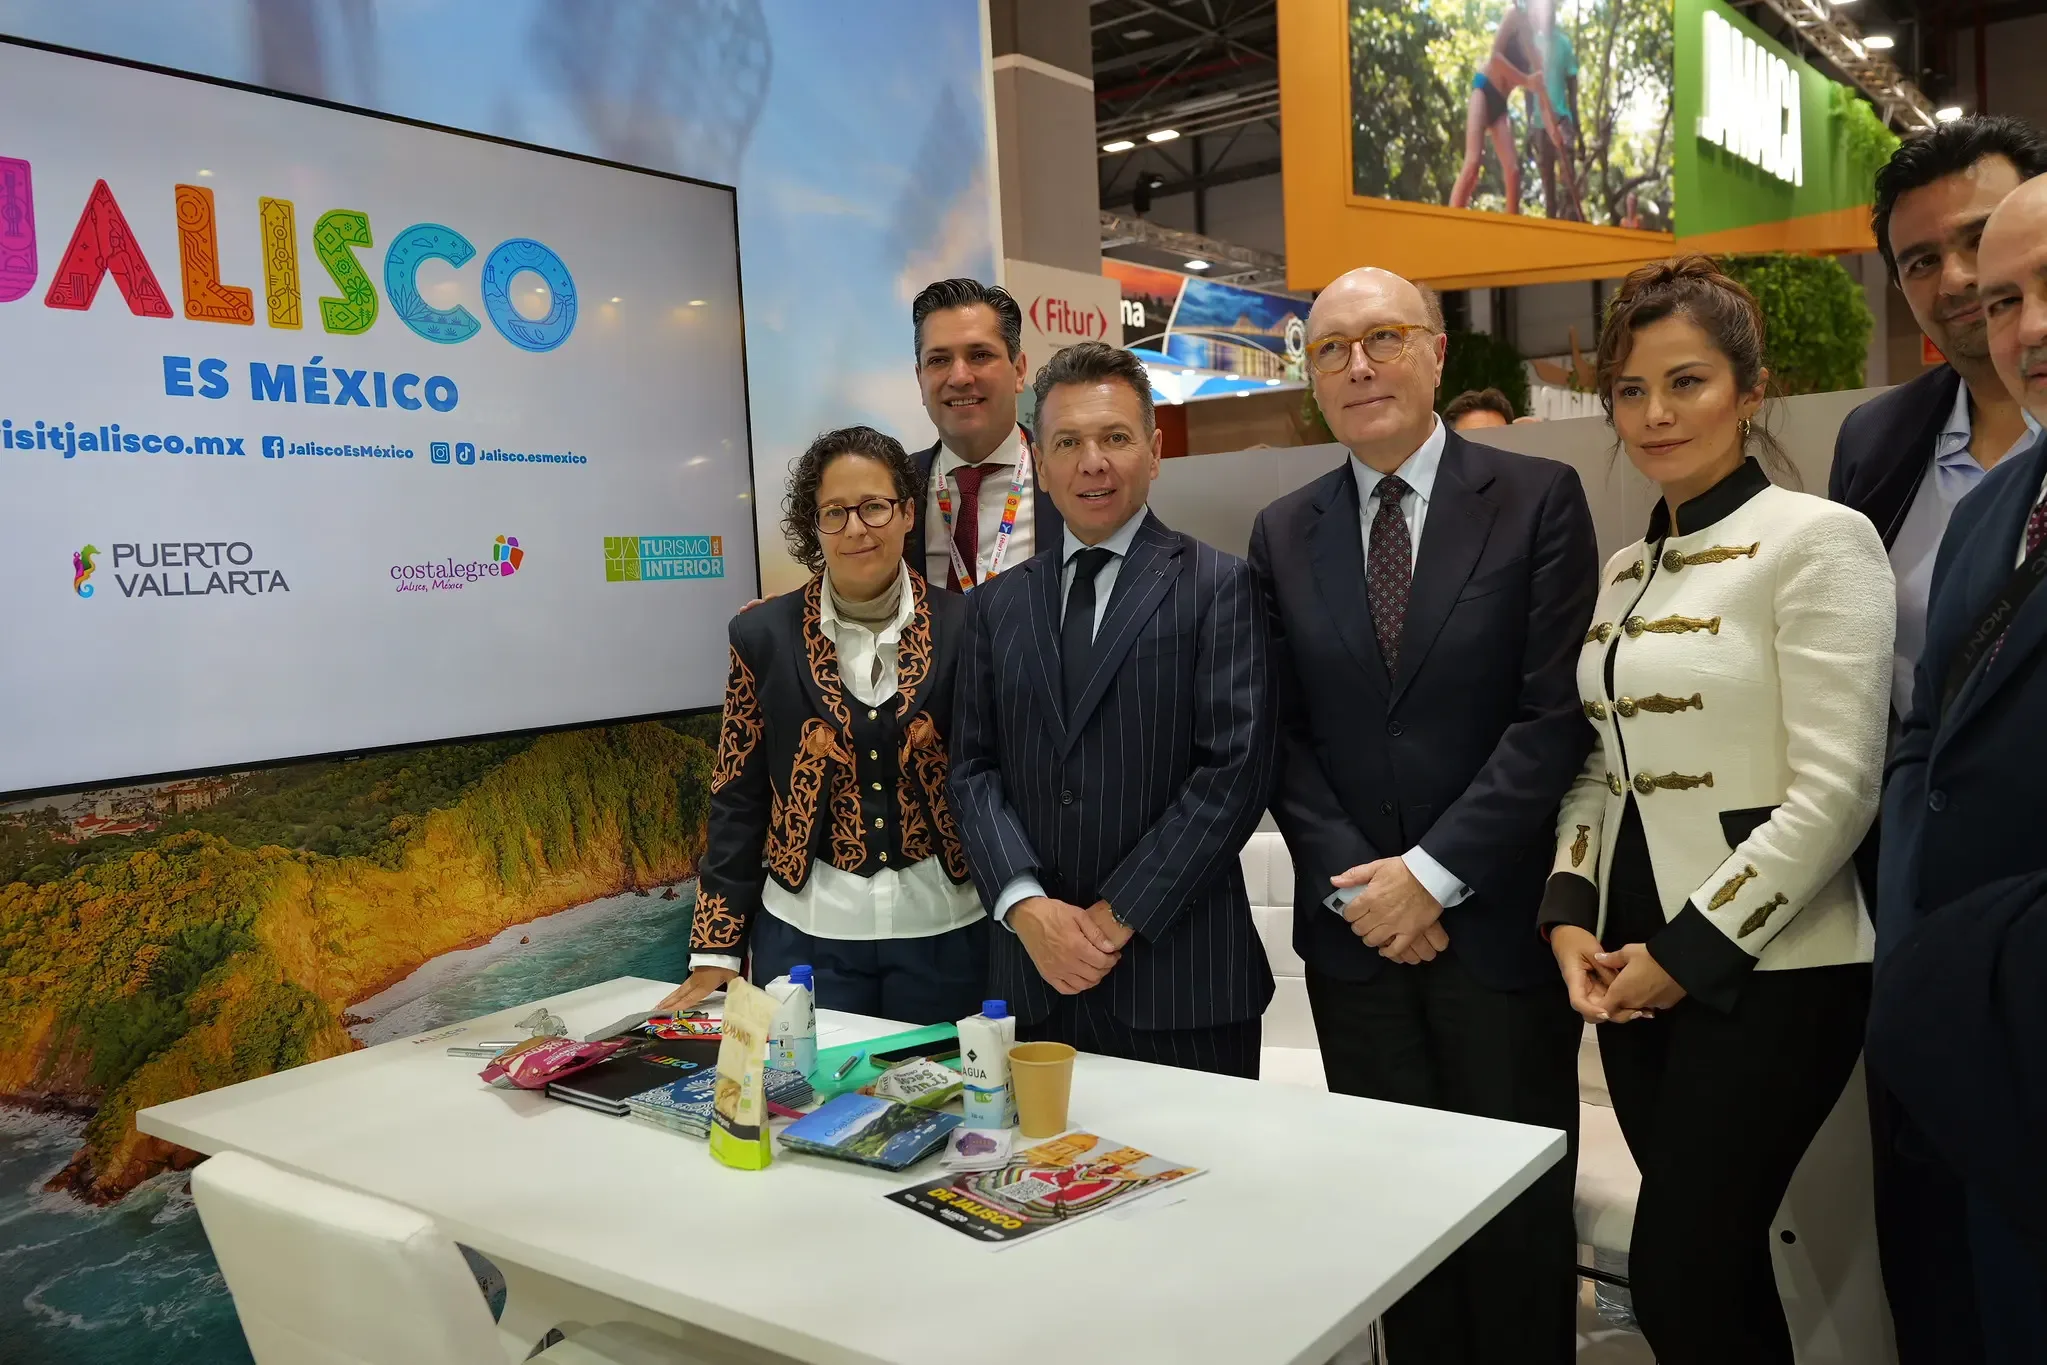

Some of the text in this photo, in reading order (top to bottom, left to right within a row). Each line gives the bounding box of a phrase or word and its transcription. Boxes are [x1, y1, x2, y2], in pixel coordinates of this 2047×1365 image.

[163, 355, 459, 412] ES MÉXICO
[0, 419, 246, 459] isitjalisco.mx
[288, 442, 414, 460] JaliscoEsMéxico
[479, 449, 588, 465] Jalisco.esmexico
[112, 541, 254, 569] PUERTO
[641, 539, 710, 556] TURISMO
[390, 557, 500, 582] costalegre
[645, 558, 722, 577] INTERIOR
[114, 569, 291, 597] VALLARTA
[432, 578, 464, 592] México
[962, 1066, 987, 1079] AGUA
[948, 1193, 1023, 1230] JALISCO
